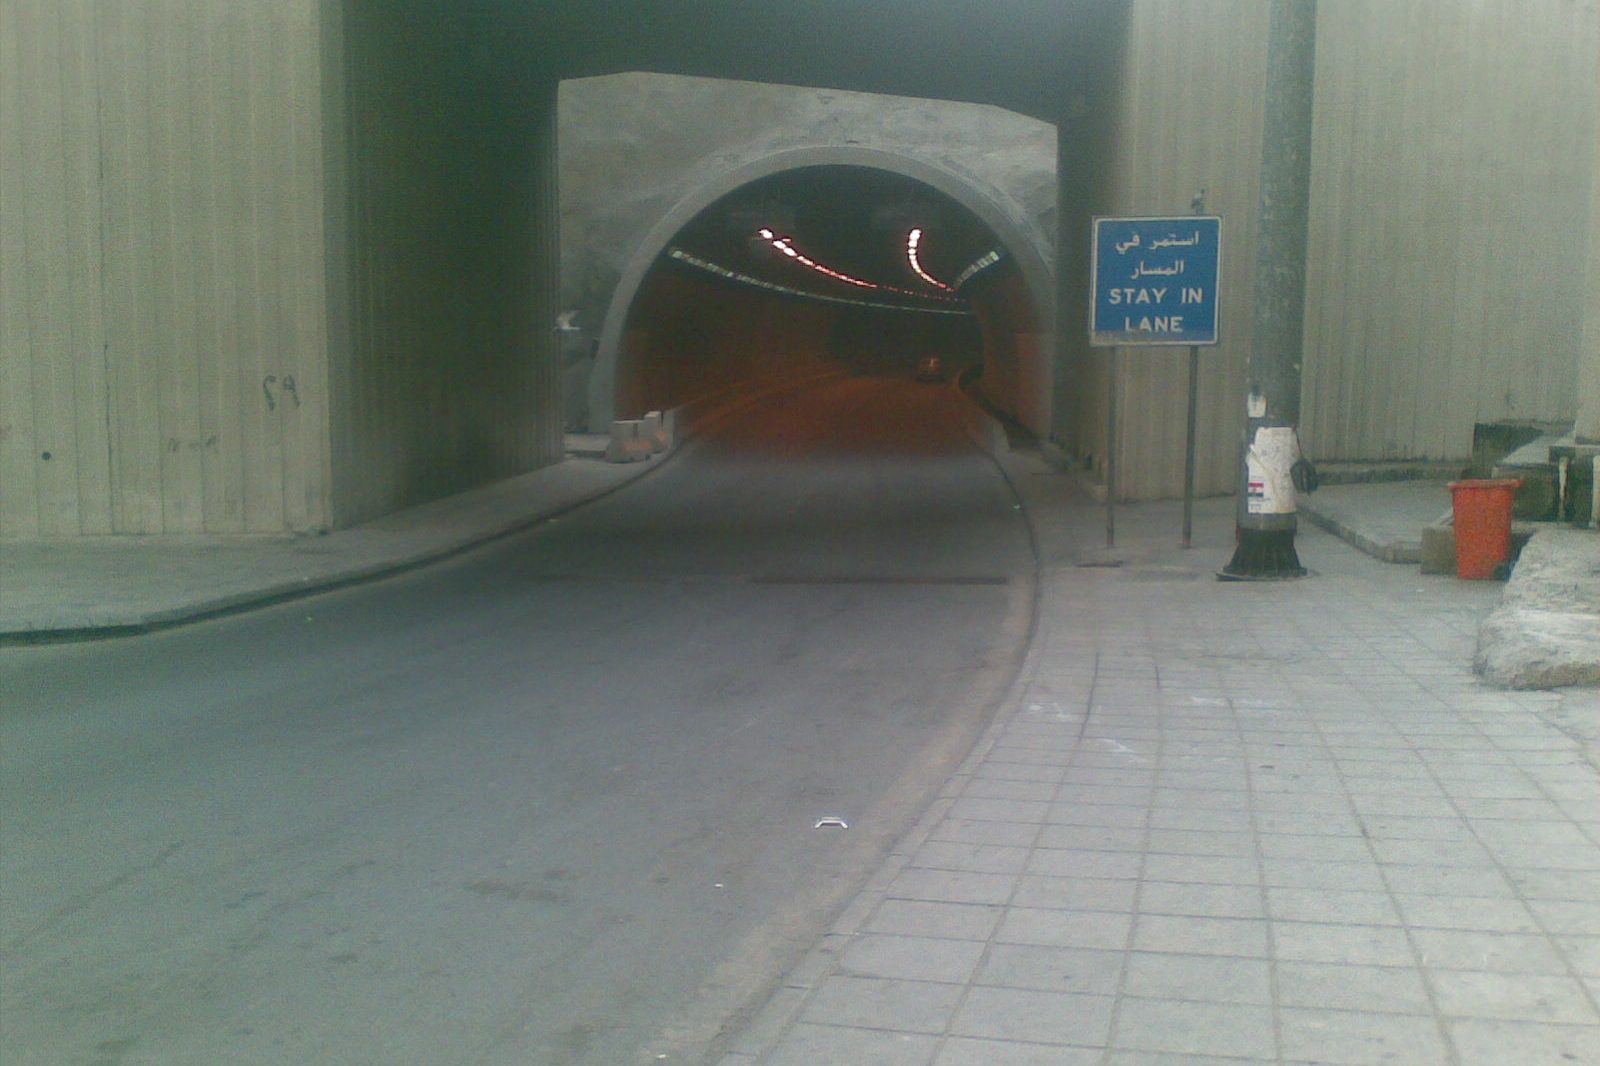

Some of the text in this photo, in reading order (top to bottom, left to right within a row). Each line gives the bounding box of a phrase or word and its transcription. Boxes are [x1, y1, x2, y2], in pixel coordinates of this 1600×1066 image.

[1116, 231, 1199, 254] استمر في
[1131, 260, 1184, 279] المسار
[1109, 288, 1203, 304] STAY IN
[1125, 317, 1184, 333] LANE
